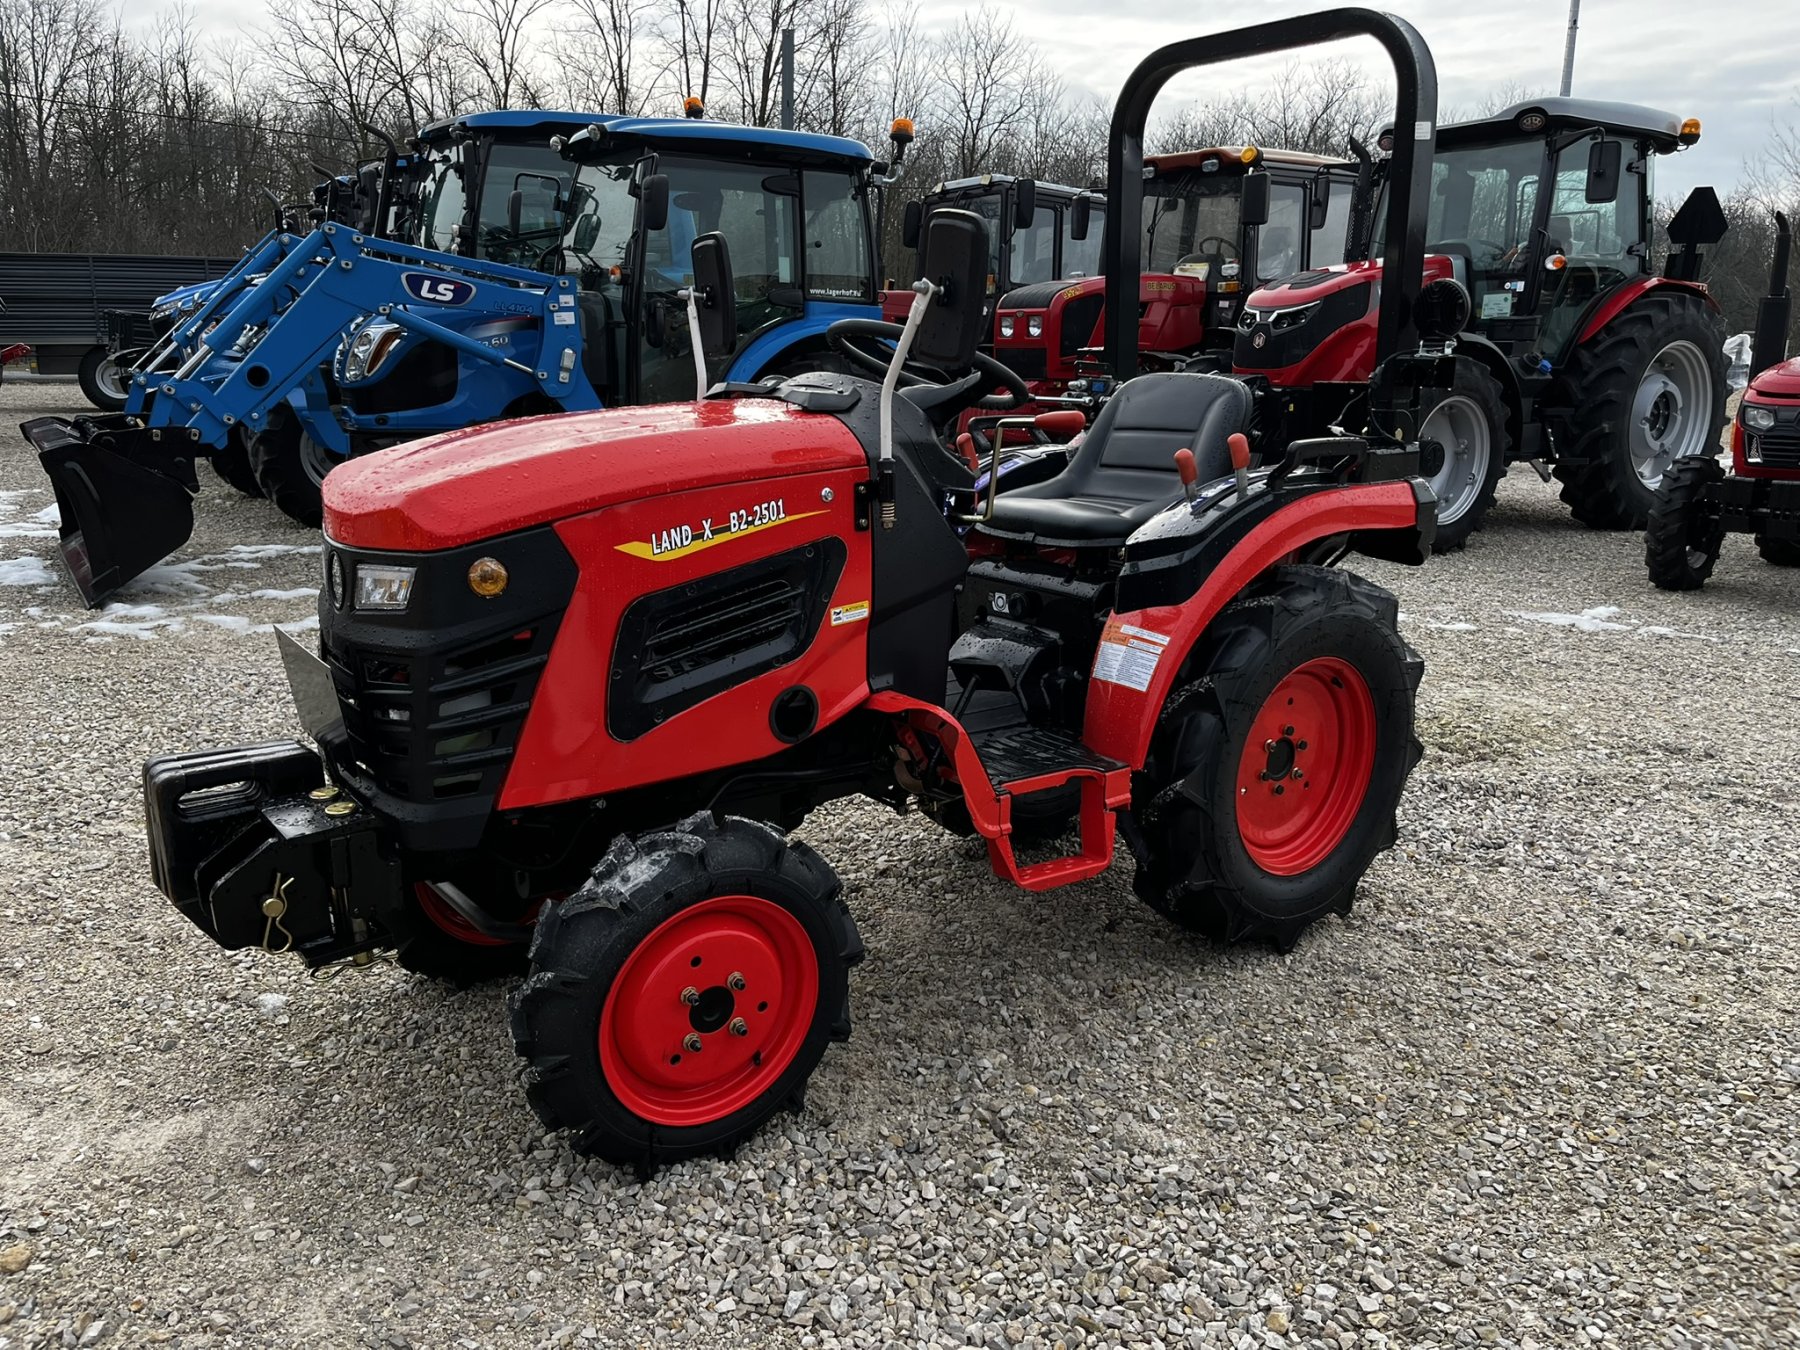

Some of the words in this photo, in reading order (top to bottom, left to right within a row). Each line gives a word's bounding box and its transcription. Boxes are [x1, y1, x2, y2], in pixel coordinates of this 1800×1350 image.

[420, 280, 455, 301] LS
[651, 525, 693, 555] LAND
[702, 518, 713, 541] X
[730, 498, 786, 533] B2-2501
